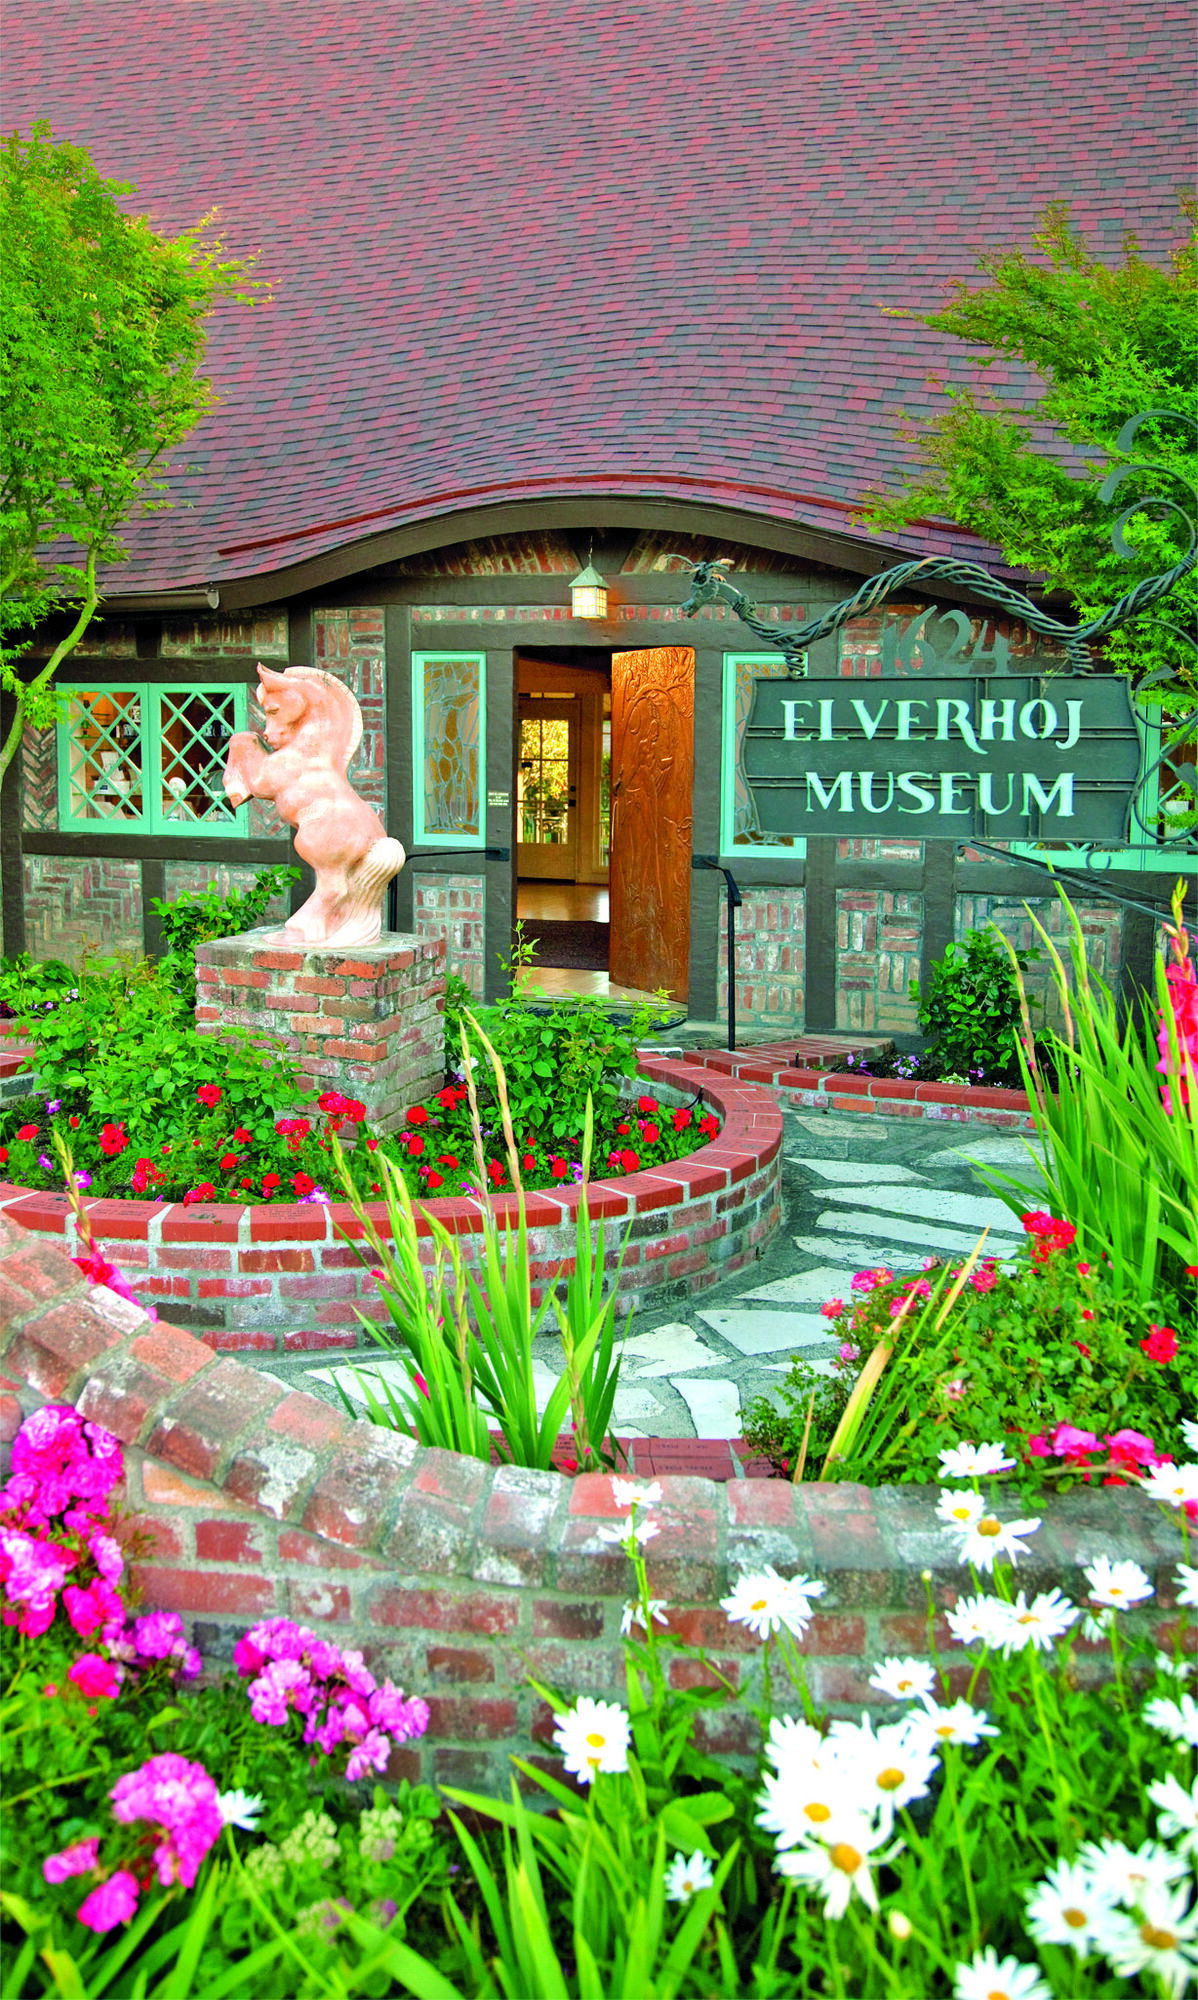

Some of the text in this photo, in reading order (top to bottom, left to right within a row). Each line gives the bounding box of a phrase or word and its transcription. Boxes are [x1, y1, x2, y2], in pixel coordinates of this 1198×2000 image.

[881, 604, 1014, 675] 1624
[780, 698, 1083, 754] ELVERHOJ
[804, 771, 1075, 817] MUSEUM
